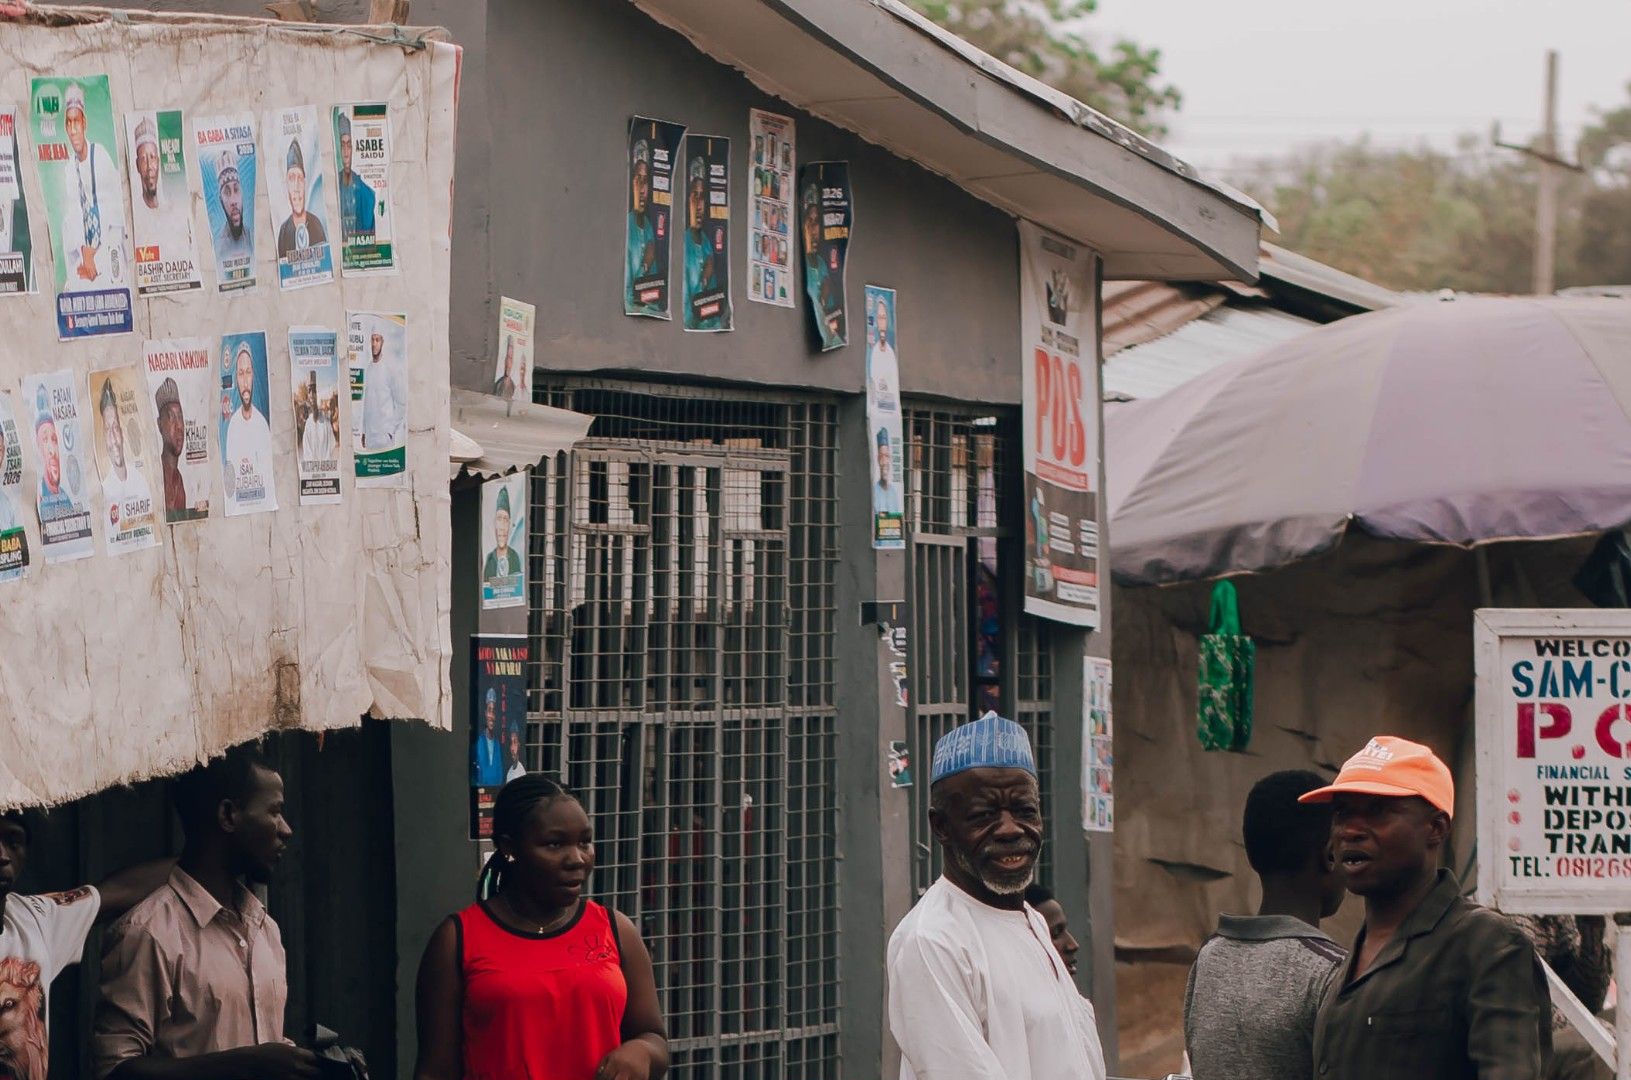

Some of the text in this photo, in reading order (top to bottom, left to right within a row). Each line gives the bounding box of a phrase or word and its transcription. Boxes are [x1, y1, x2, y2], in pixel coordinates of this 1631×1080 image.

[355, 138, 384, 152] ASABE
[138, 261, 194, 276] BASHIR DAUDA
[148, 349, 209, 372] NAGARI NAKOWA
[53, 403, 77, 420] NASARA
[1035, 345, 1086, 467] POS
[240, 463, 254, 475] ISAH
[3, 471, 22, 486] 2026
[236, 474, 264, 489] ZUBAIRU
[126, 499, 151, 516] SHARIF
[1, 537, 22, 552] BABA
[1537, 765, 1610, 779] FINANCIAL
[1544, 810, 1631, 830] DEPO
[1510, 856, 1551, 877] TEL:
